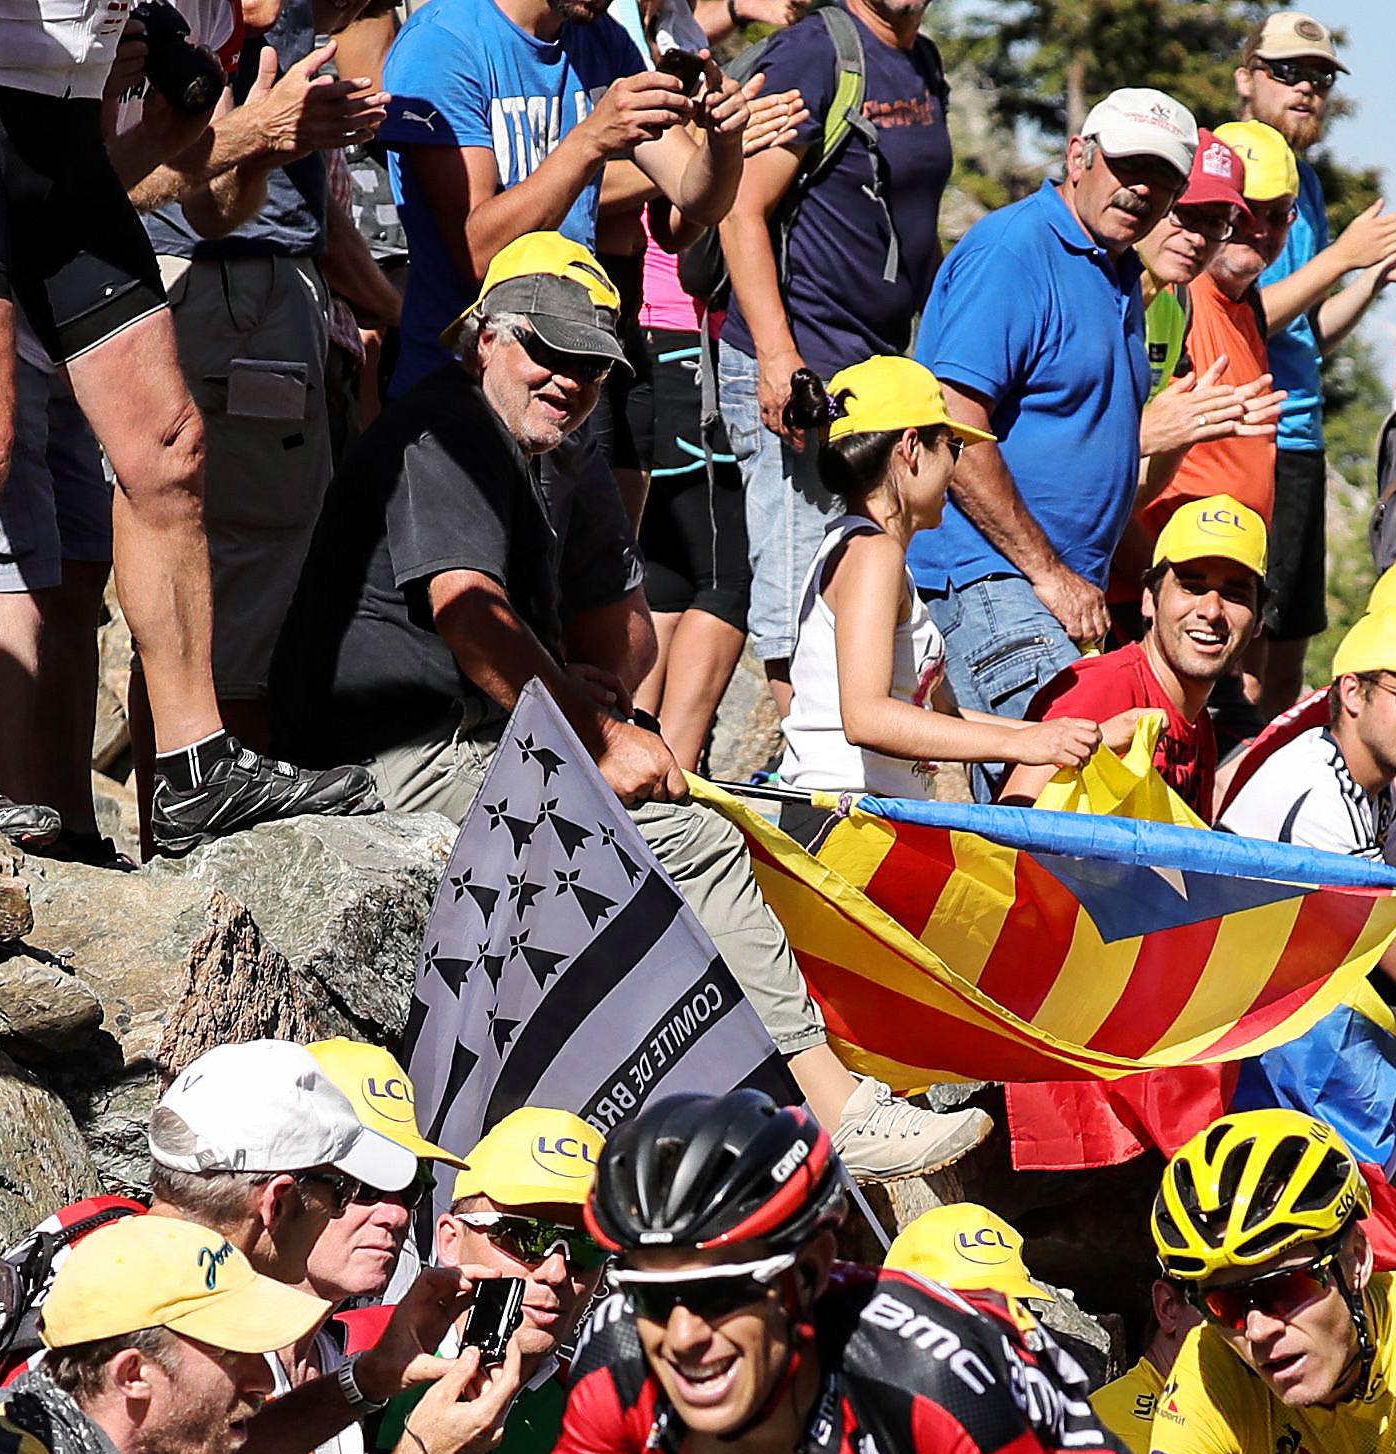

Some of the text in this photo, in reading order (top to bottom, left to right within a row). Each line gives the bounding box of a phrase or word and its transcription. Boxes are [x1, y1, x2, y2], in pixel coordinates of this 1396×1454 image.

[1201, 510, 1247, 532] LCL
[368, 1077, 416, 1104] LCL
[539, 1136, 598, 1166] LCL
[959, 1228, 1014, 1249] LCL
[860, 1292, 995, 1396] BMC
[1133, 1392, 1156, 1416] LCL
